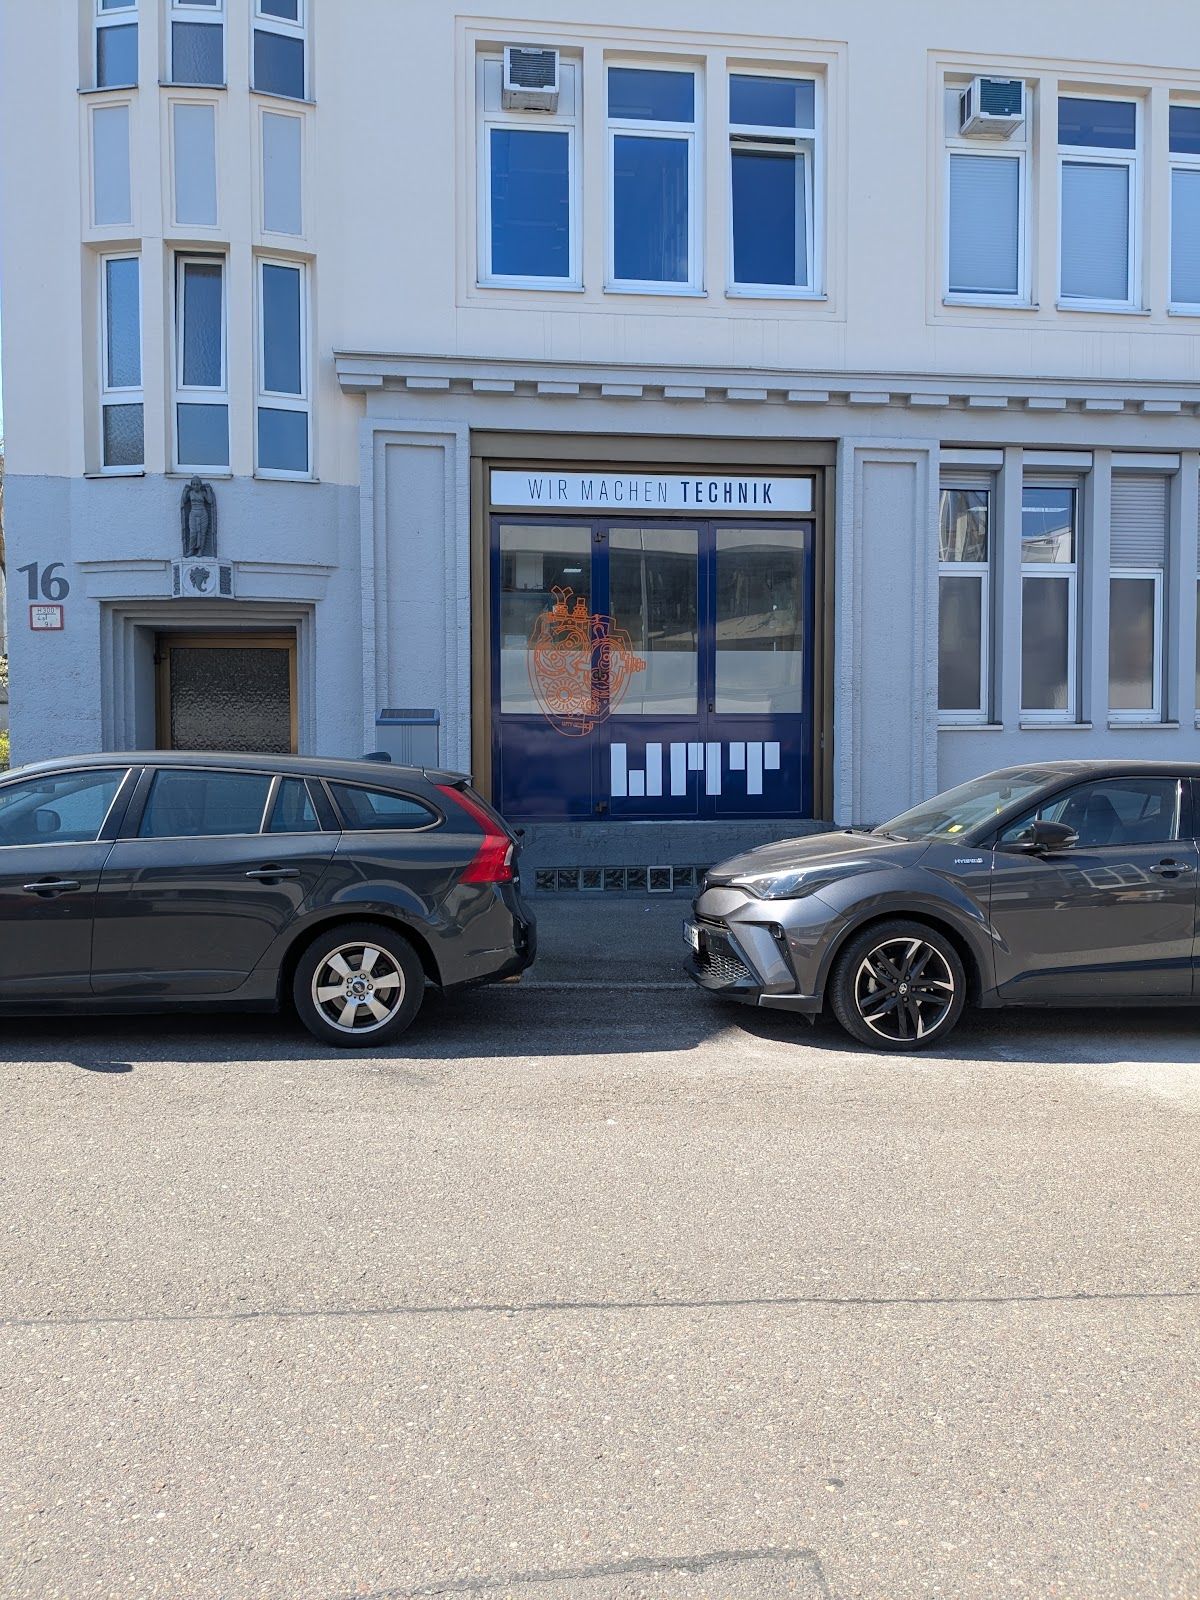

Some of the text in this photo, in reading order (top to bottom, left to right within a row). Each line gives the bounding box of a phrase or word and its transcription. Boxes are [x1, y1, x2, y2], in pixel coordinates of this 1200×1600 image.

[527, 478, 773, 504] WIR MACHEN TECHNIK
[15, 560, 70, 601] 16
